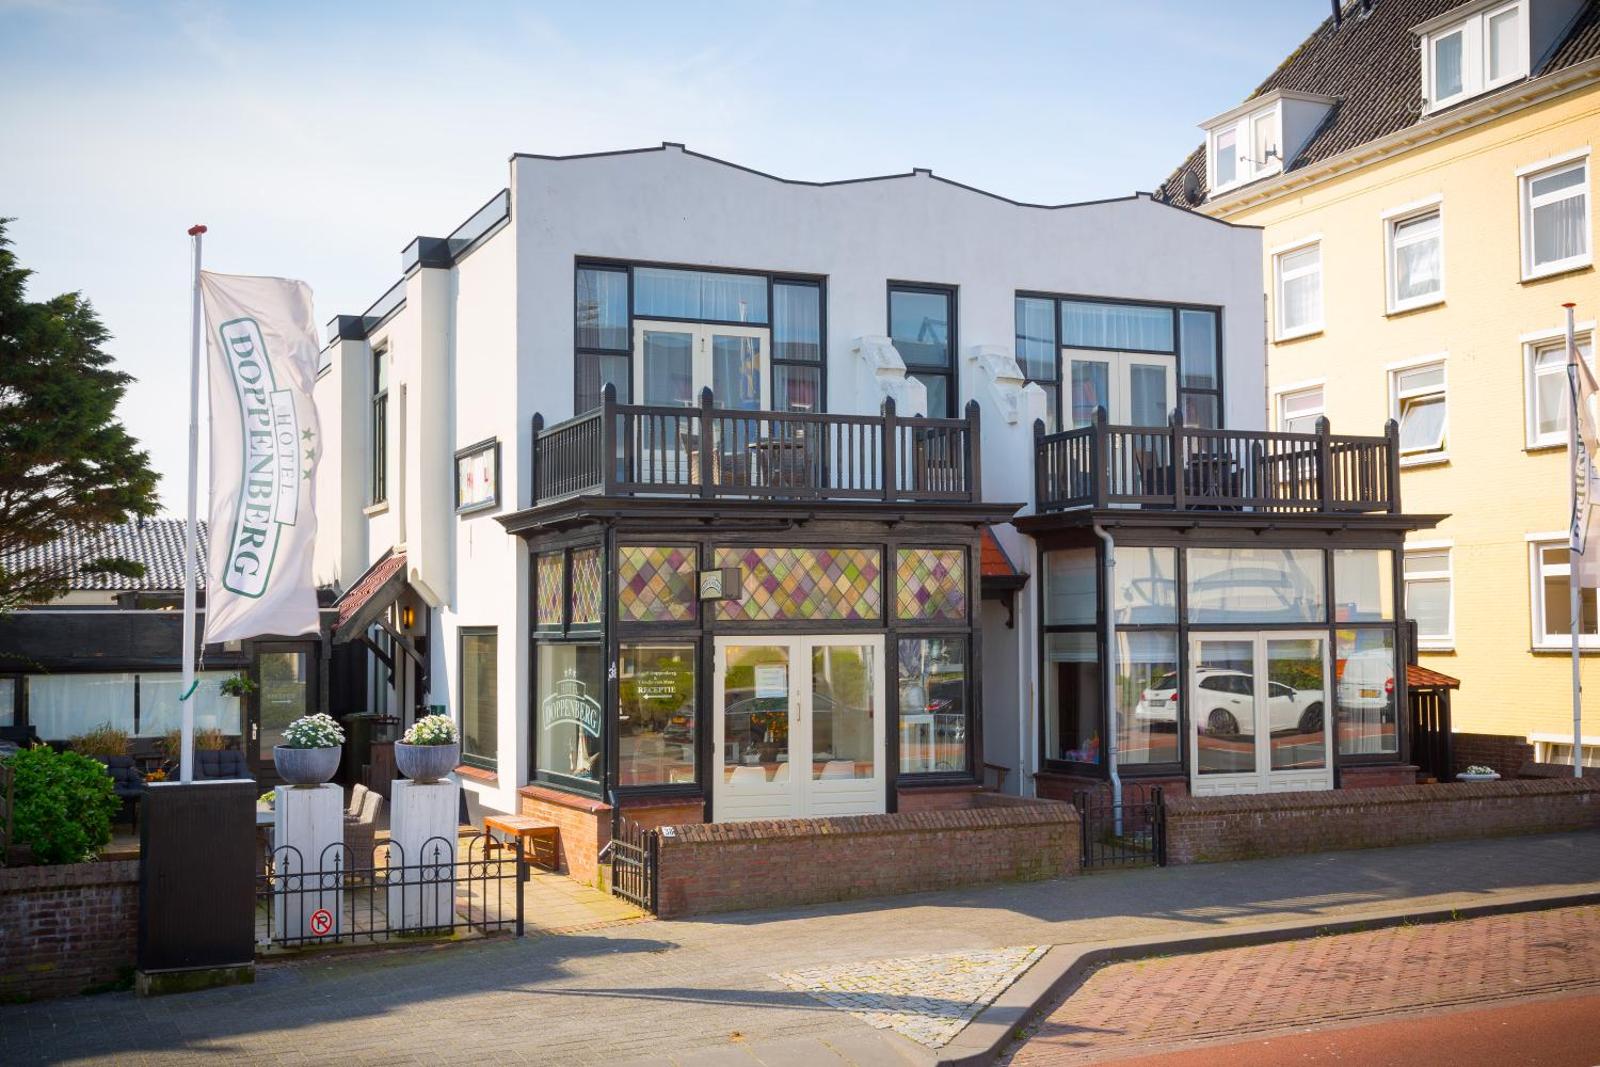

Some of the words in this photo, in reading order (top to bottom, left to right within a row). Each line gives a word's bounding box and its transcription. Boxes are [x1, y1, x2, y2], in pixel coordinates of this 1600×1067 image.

[230, 333, 274, 577] DOPPENBERG
[276, 411, 294, 496] HOTEL
[545, 698, 597, 729] DOPPENBERG
[637, 686, 676, 694] RECEPTIE
